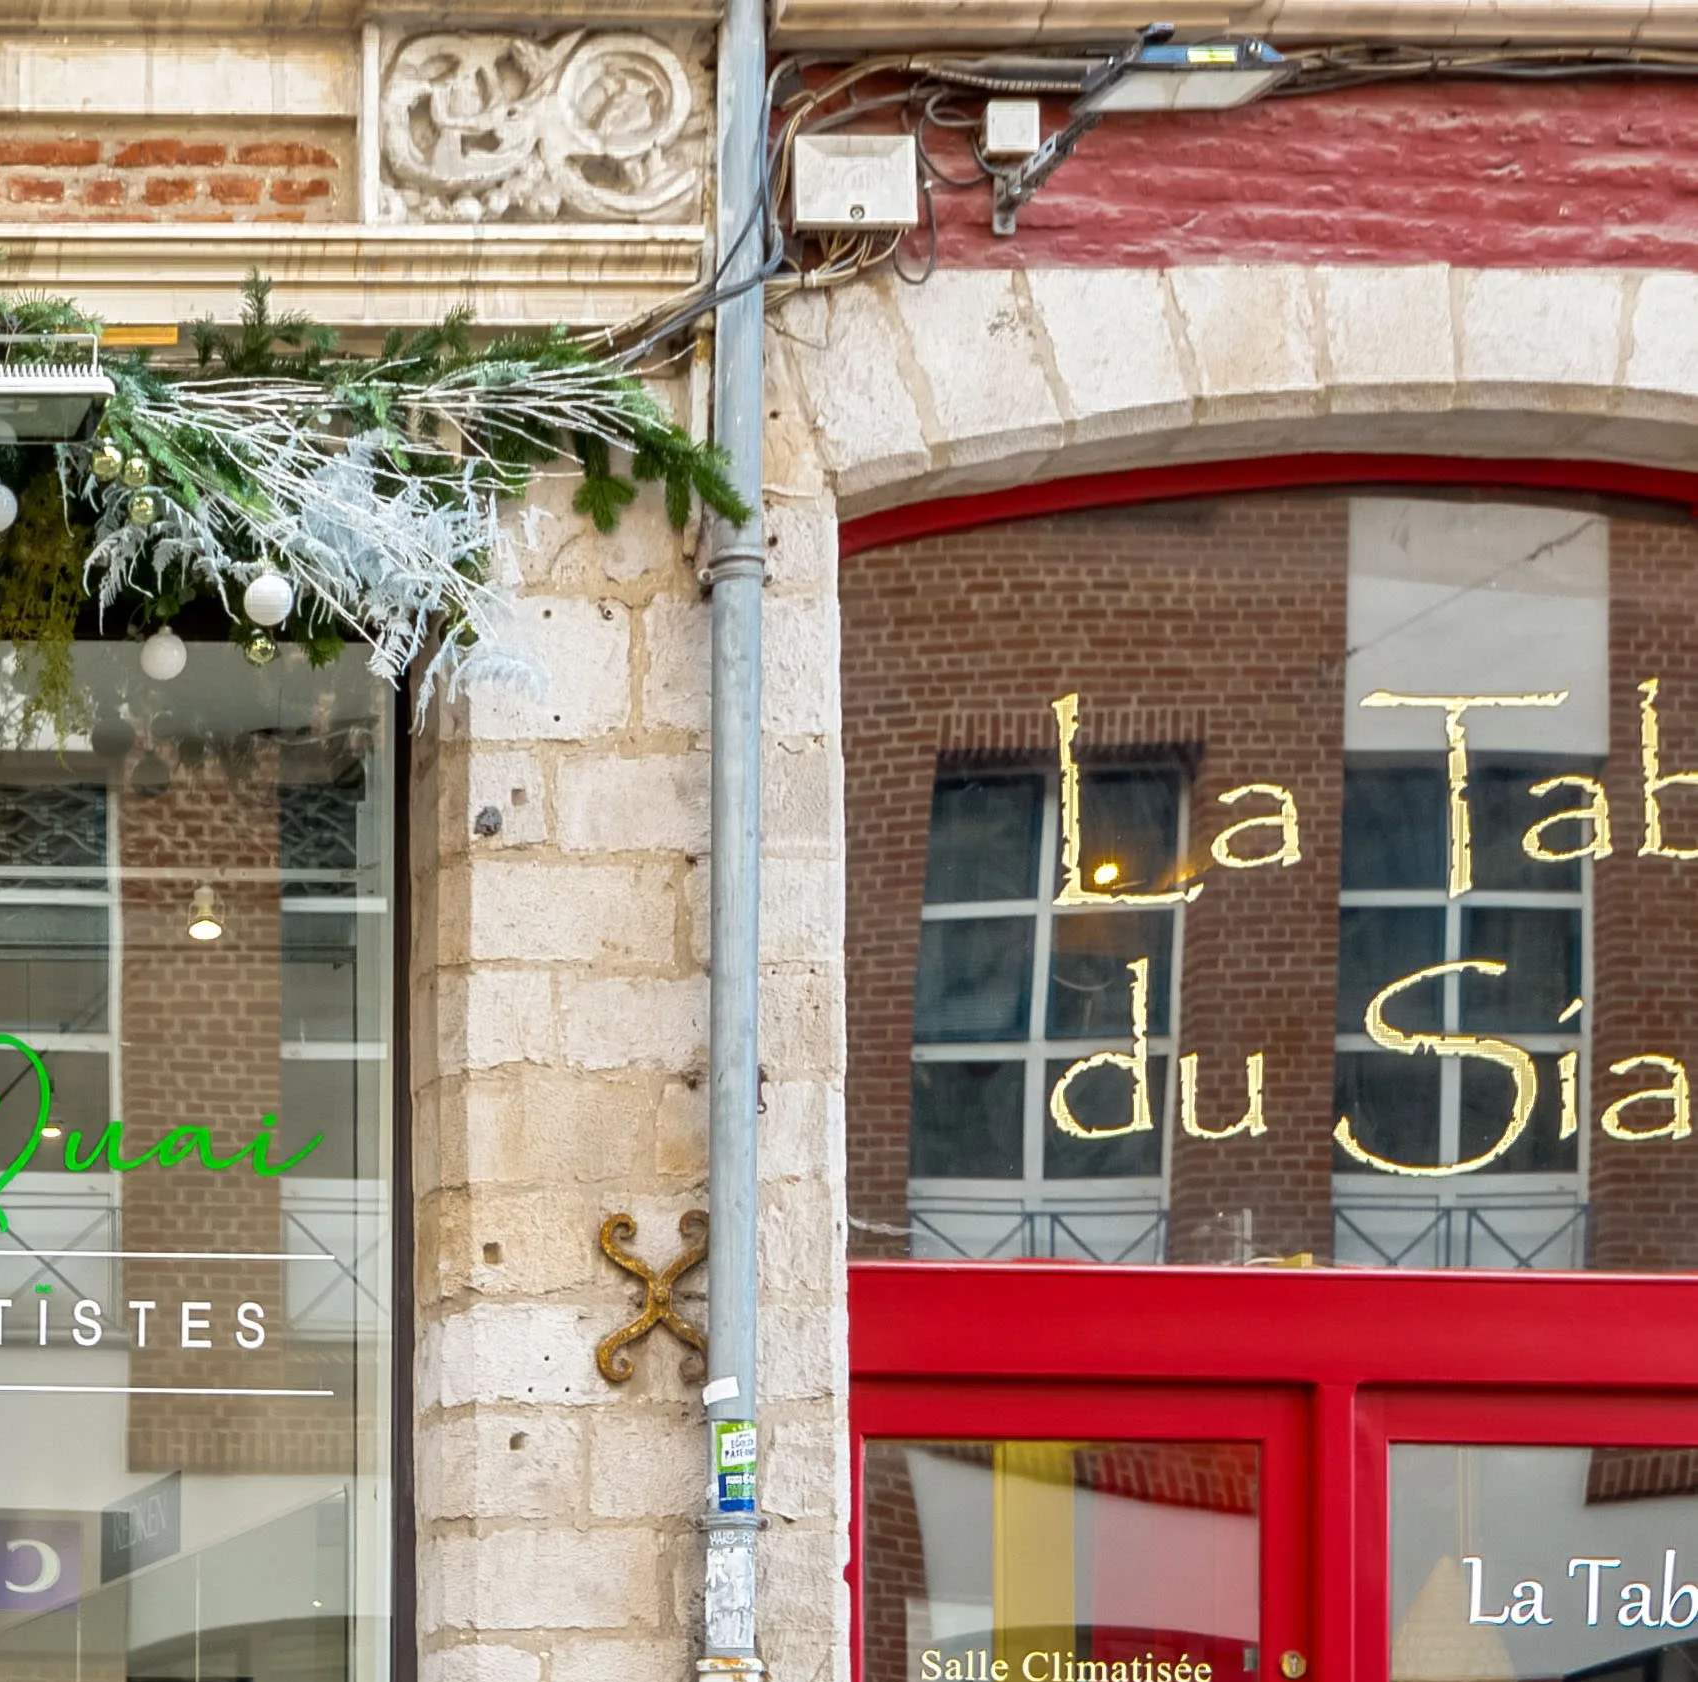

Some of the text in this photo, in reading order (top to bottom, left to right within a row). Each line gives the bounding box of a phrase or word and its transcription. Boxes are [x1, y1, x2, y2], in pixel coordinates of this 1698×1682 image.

[1051, 691, 1302, 907] La
[1050, 957, 1692, 1177] du Sia
[1463, 1548, 1698, 1629] La Tab
